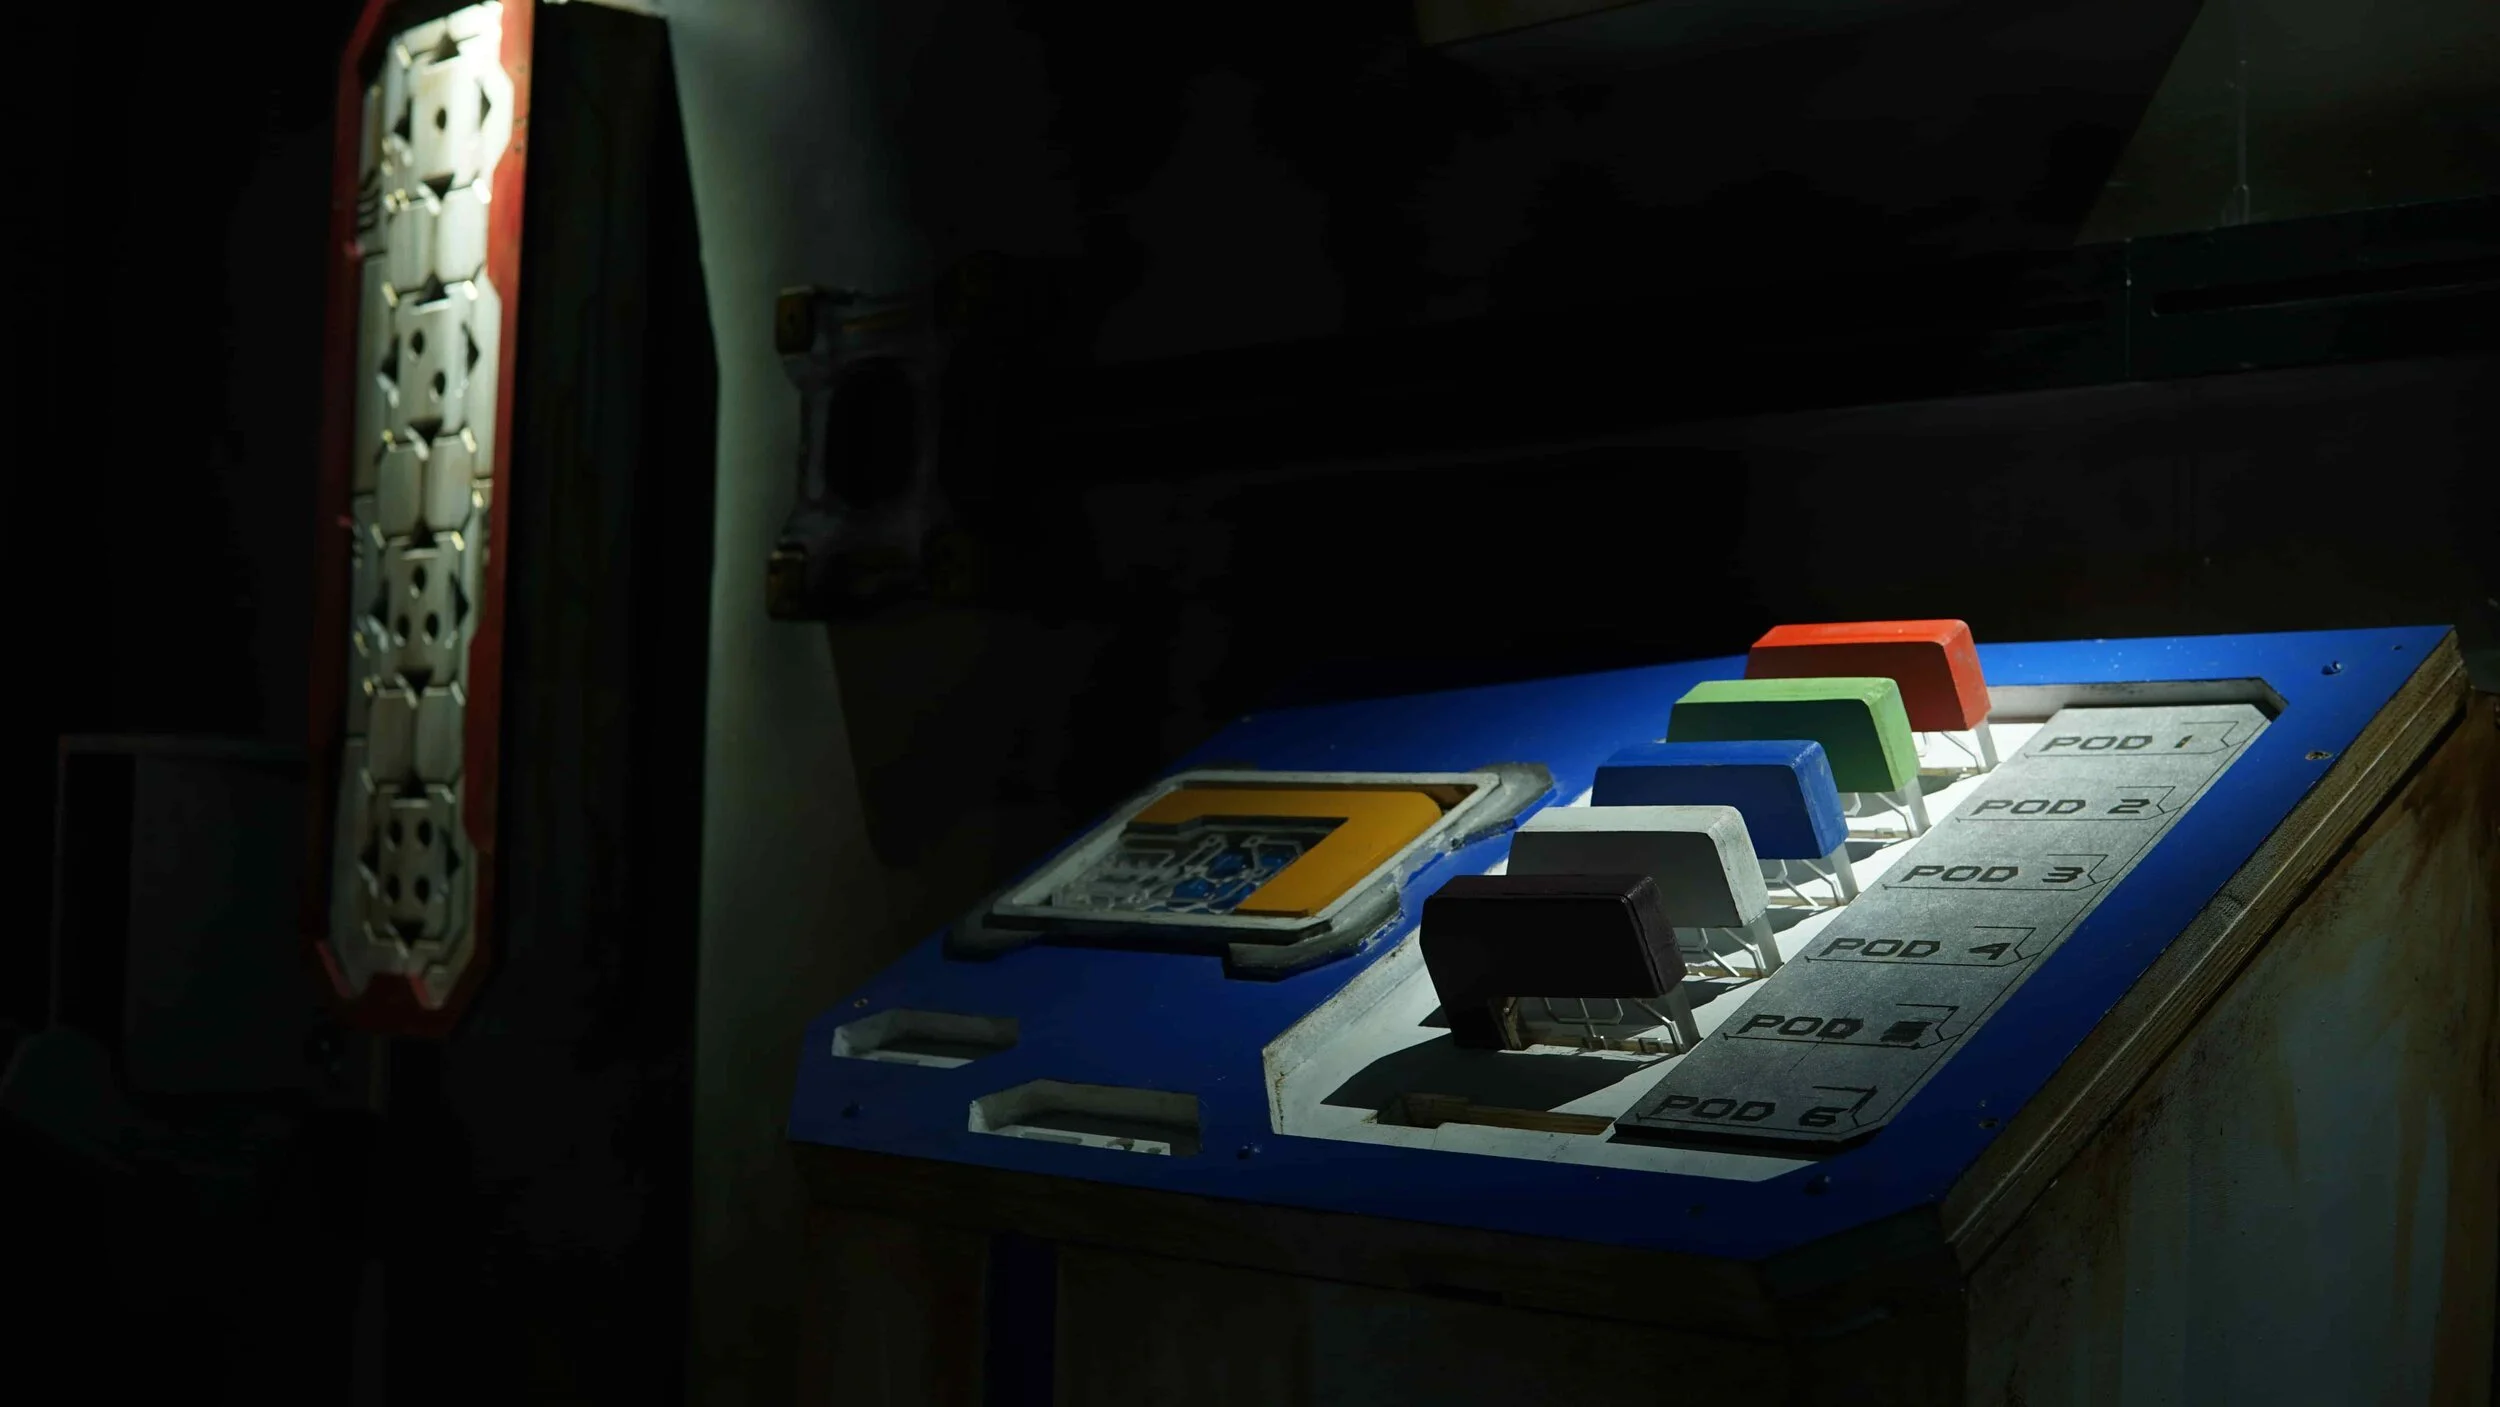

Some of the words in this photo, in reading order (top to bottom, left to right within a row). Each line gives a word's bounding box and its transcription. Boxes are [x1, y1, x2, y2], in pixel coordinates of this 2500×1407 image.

[2040, 735, 2153, 752] POD
[2173, 734, 2194, 750] 1
[1970, 799, 2087, 816] POD
[2107, 798, 2151, 814] 2
[1901, 865, 2020, 883] POD
[2041, 866, 2085, 883] 3
[1818, 937, 1941, 959] POD
[1967, 942, 2012, 960] 4
[1736, 1013, 1865, 1040] POD
[1648, 1094, 1776, 1122] POD
[1798, 1106, 1851, 1128] 6
